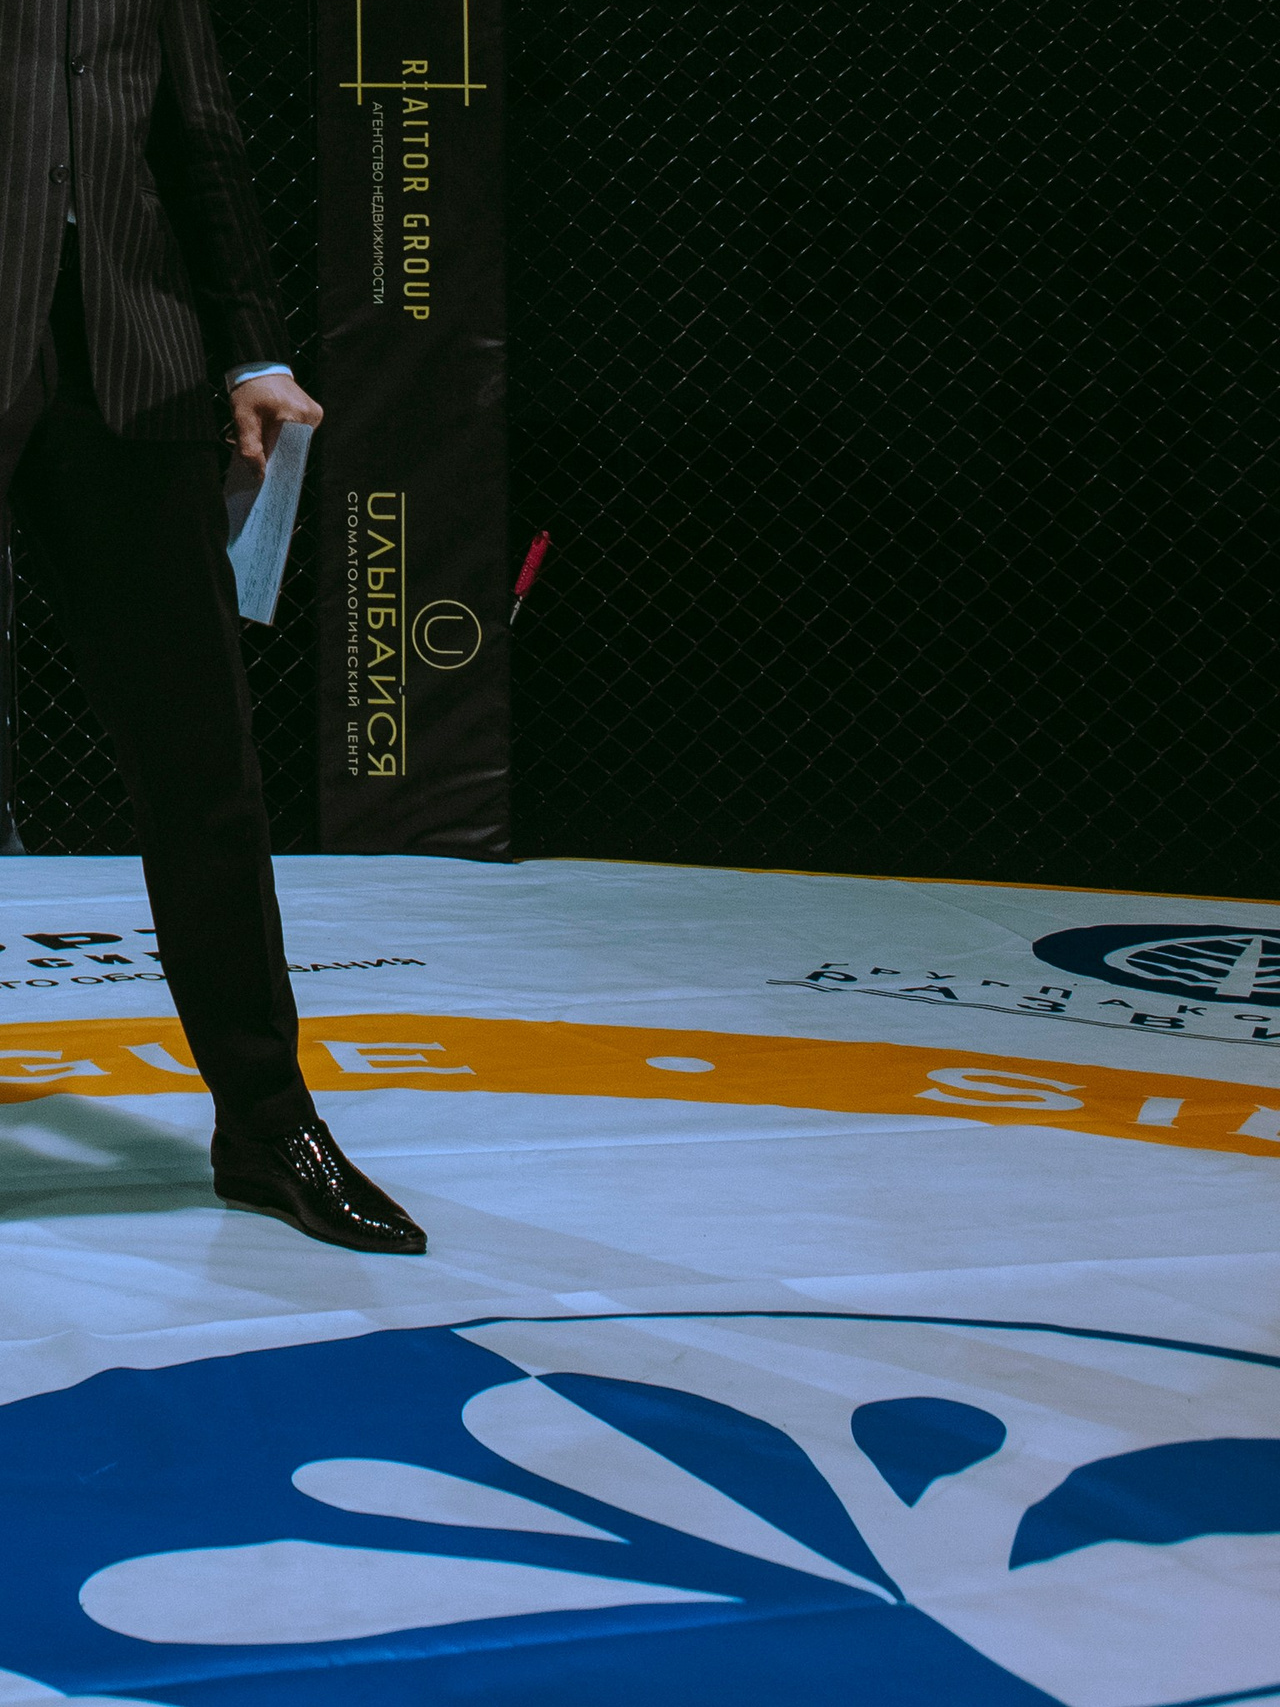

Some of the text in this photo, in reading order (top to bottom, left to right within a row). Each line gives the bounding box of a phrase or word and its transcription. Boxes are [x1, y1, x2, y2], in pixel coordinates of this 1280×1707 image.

[372, 101, 384, 304] АГЕНТСТВО НЕДВИЖИМОСТИ
[402, 212, 430, 321] GROUP
[347, 491, 360, 776] СТОМАТОЛОГИЧЕСКИЙ ЦЕНТР
